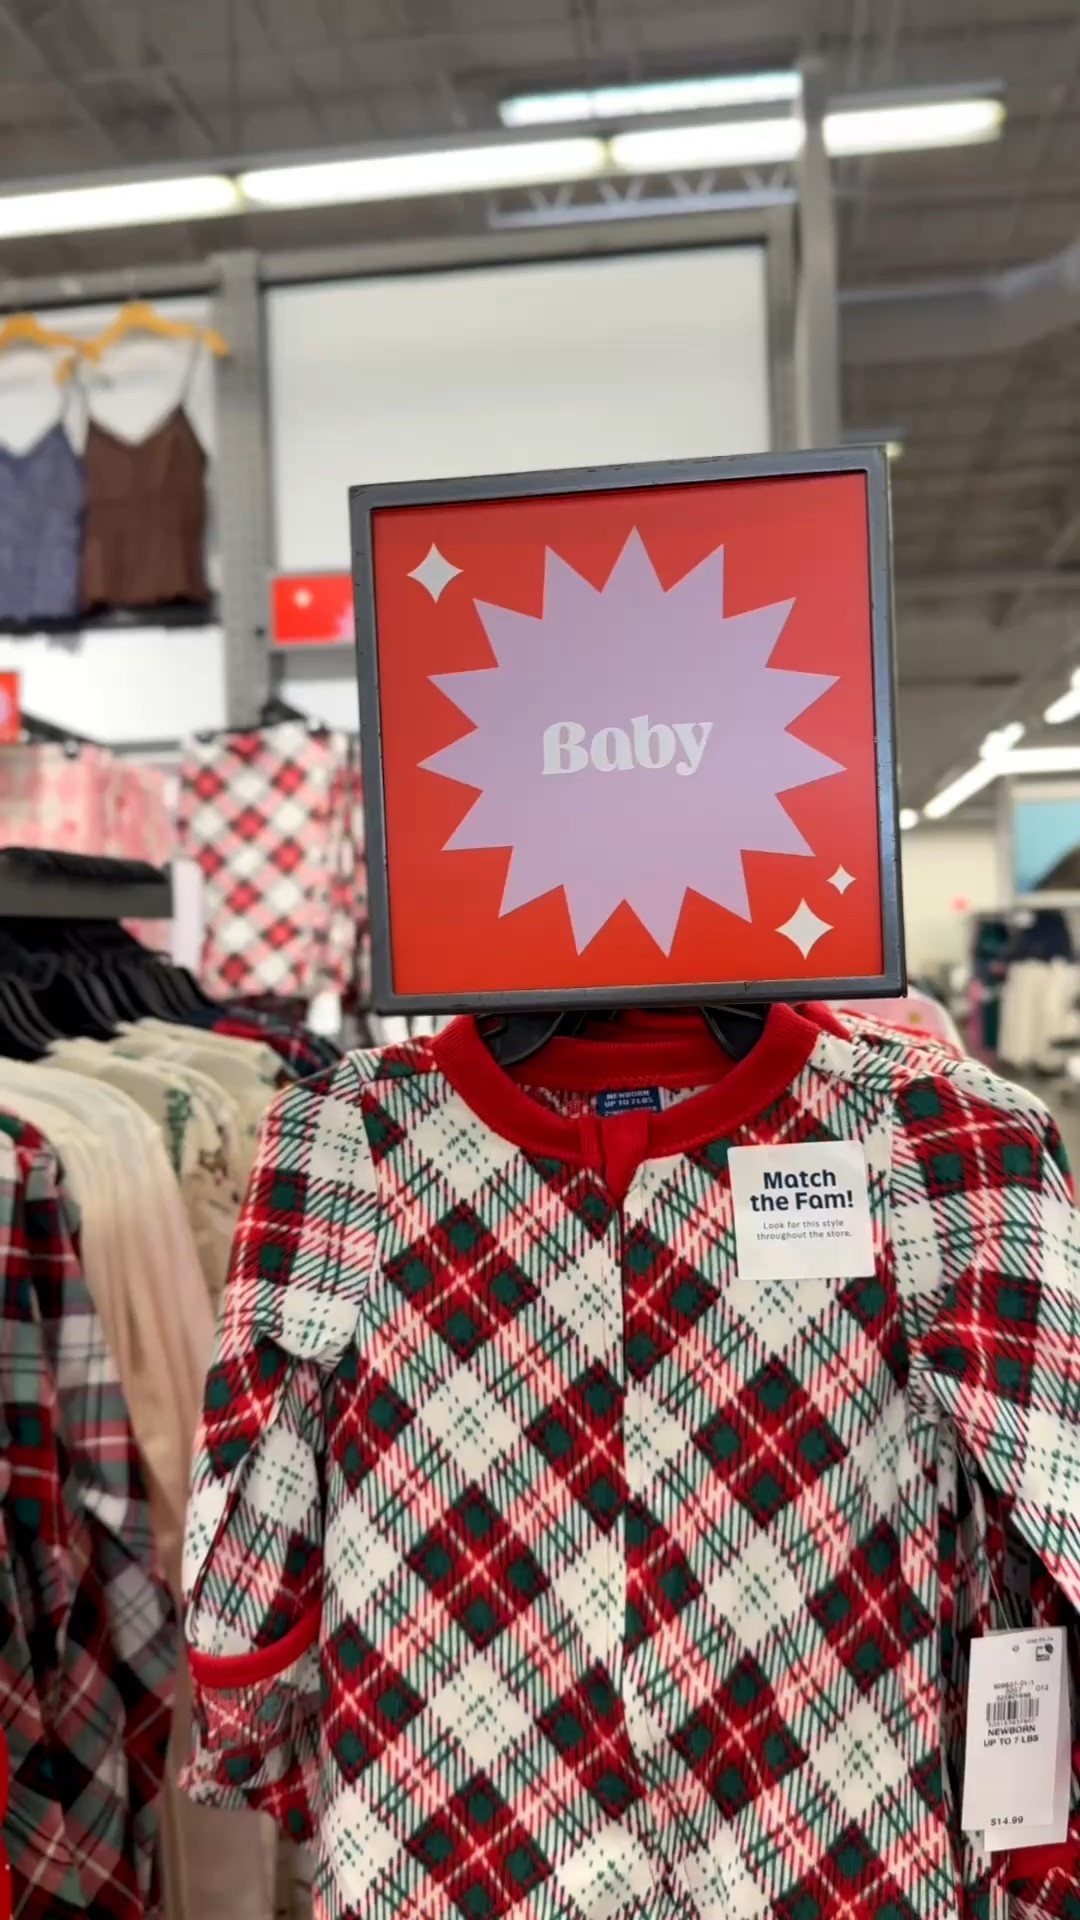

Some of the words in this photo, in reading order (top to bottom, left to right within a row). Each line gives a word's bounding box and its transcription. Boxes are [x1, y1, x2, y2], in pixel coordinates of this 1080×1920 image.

[542, 714, 714, 776] Baby
[606, 1090, 650, 1099] NEWBORN
[763, 1169, 836, 1189] Match
[750, 1194, 789, 1212] the
[795, 1190, 854, 1209] Fam!
[763, 1221, 785, 1230] Look
[803, 1220, 820, 1228] this
[822, 1219, 844, 1229] style
[757, 1231, 807, 1241] throughout
[826, 1230, 853, 1238] store.
[988, 1725, 1036, 1736] NEWBORN
[984, 1739, 996, 1747] UP
[999, 1738, 1012, 1746] TO
[1014, 1736, 1019, 1744] 7
[1021, 1734, 1039, 1743] LBS
[990, 1815, 1024, 1826] $14.99
